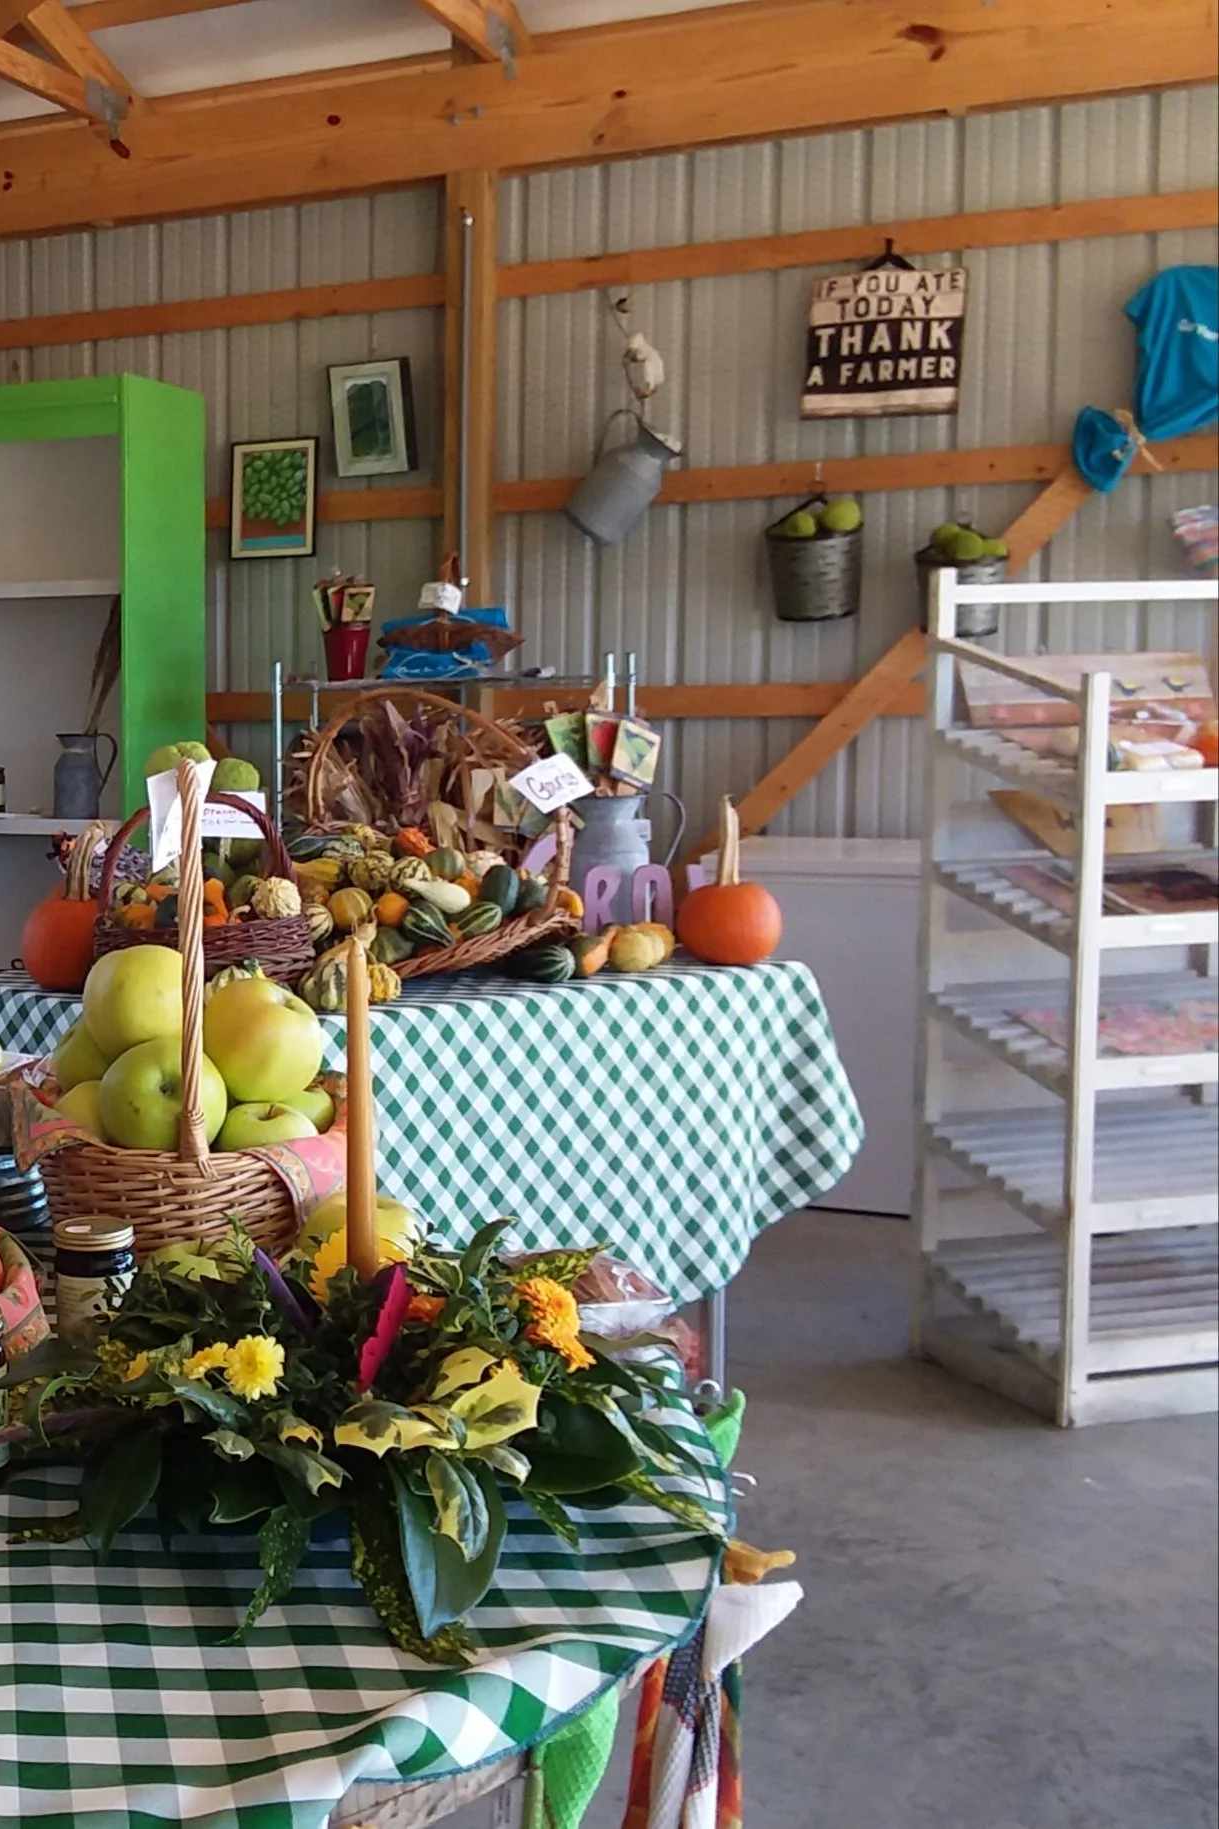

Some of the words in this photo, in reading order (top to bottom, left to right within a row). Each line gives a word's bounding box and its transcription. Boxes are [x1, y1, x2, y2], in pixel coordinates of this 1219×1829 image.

[817, 281, 838, 299] IF
[851, 274, 900, 297] YOU
[916, 271, 961, 293] ATE
[836, 295, 936, 320] TODAY
[814, 319, 954, 358] THANK
[806, 365, 825, 387] A
[839, 356, 957, 386] FARMER
